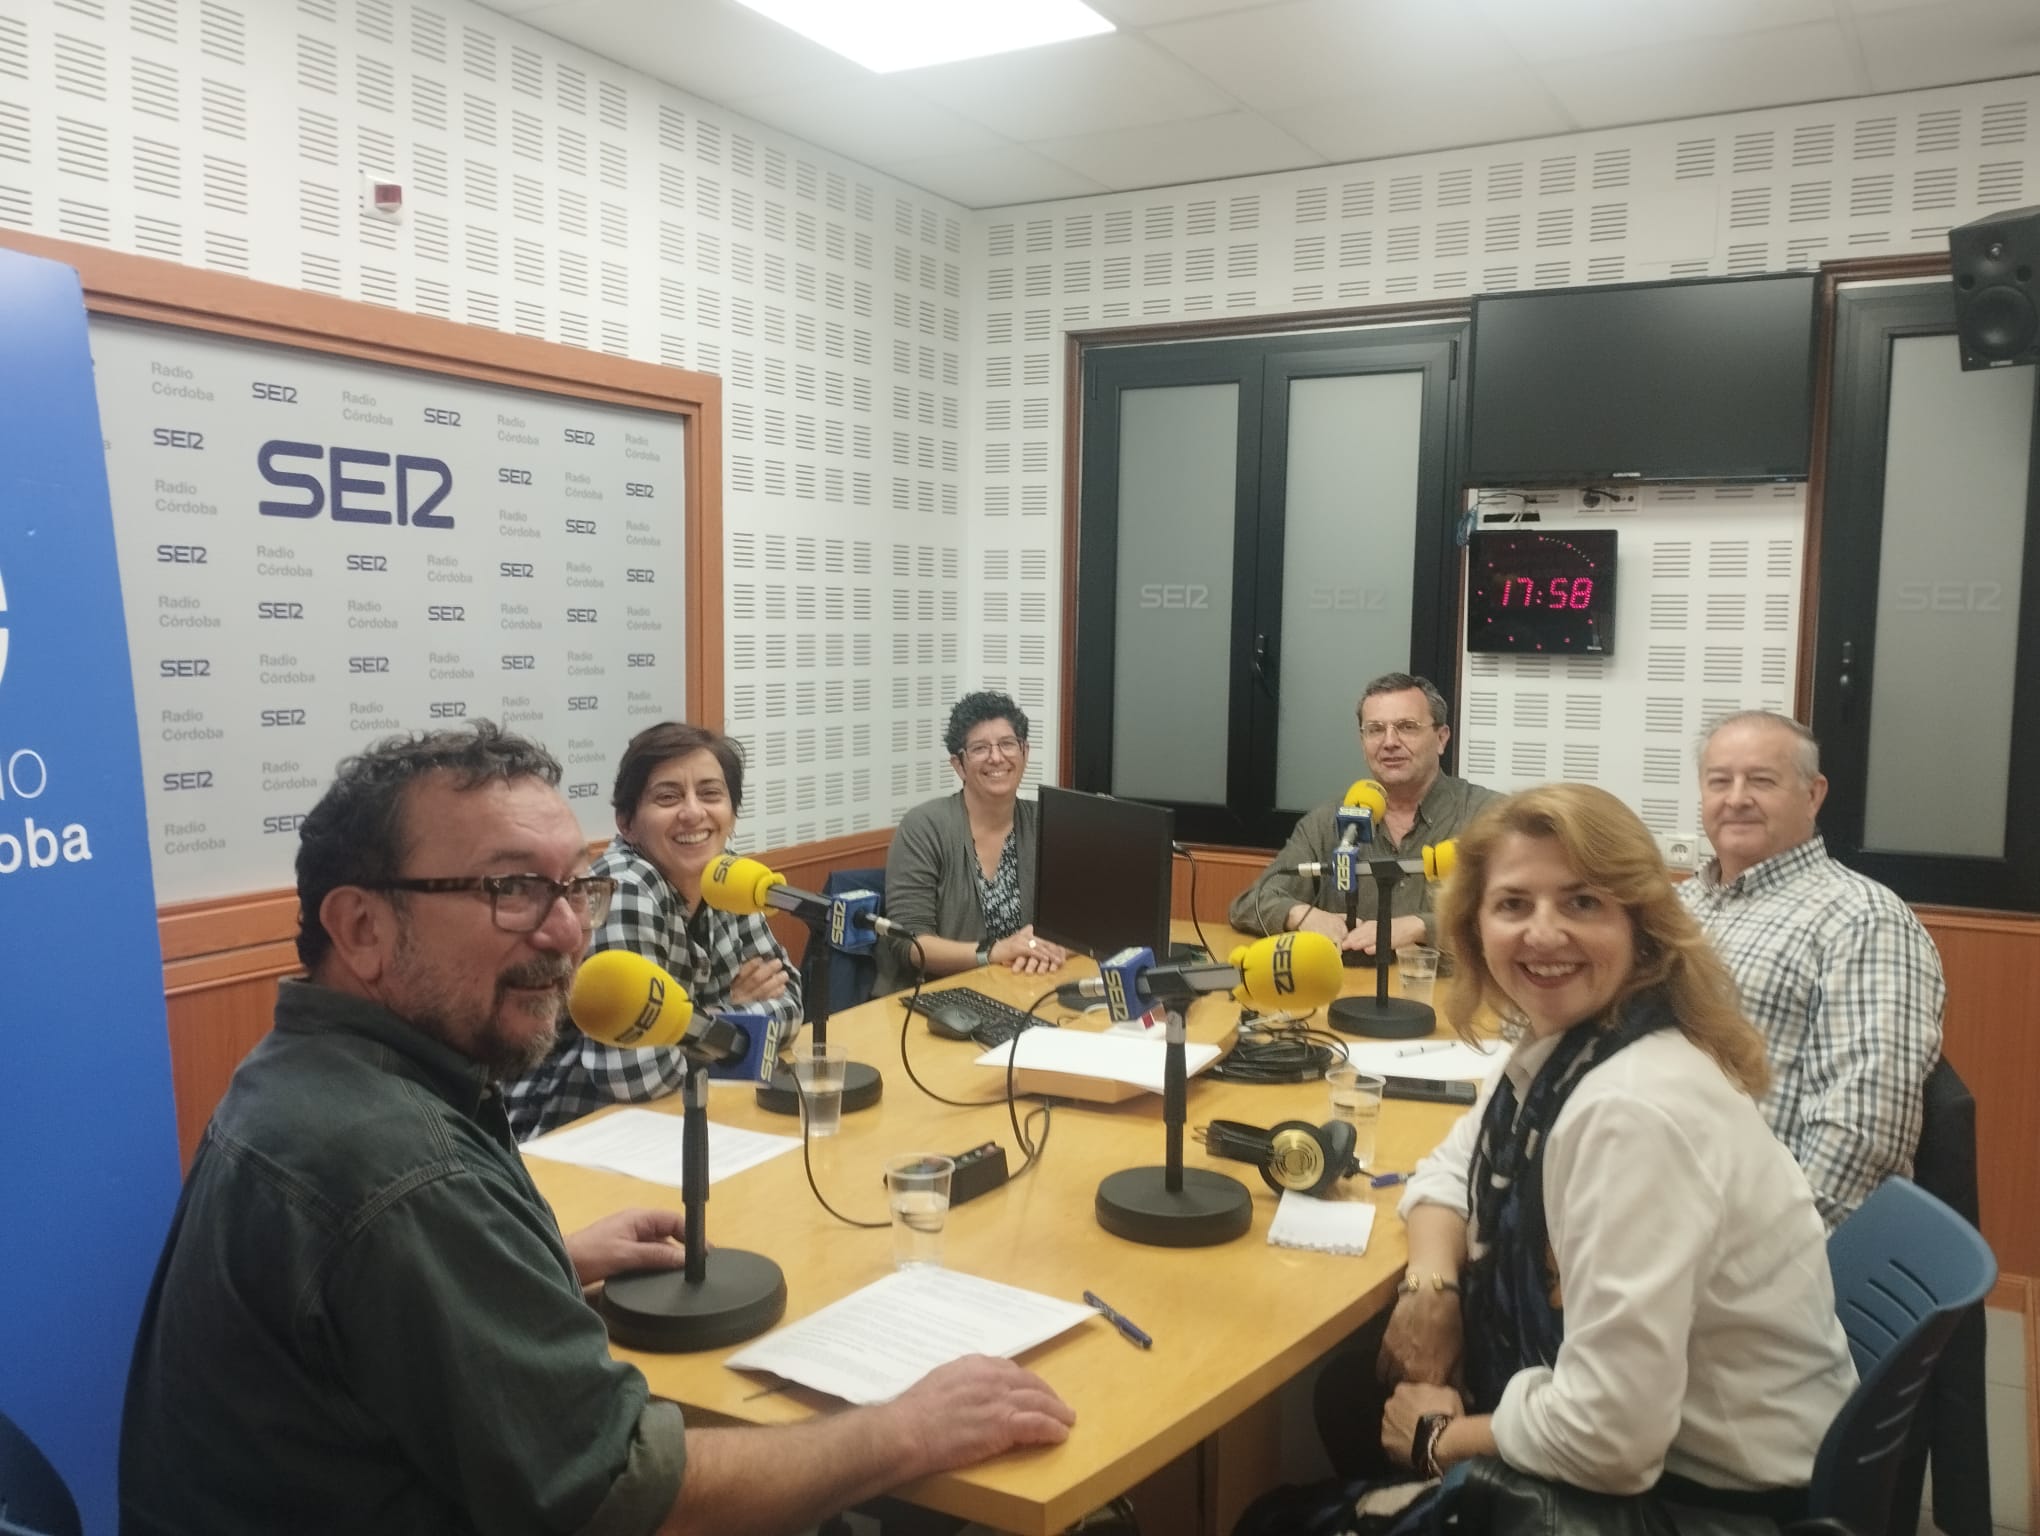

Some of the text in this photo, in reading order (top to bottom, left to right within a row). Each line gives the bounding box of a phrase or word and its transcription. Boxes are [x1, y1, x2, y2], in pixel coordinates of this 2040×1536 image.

[151, 362, 193, 380] Radio
[152, 381, 214, 402] Córdoba
[252, 382, 298, 404] SER
[342, 391, 376, 407] Radio
[424, 408, 461, 427] SER
[497, 414, 526, 429] Radio
[153, 428, 204, 450] SER
[564, 428, 595, 446] SER
[625, 433, 648, 446] Radio
[257, 439, 455, 529] SER
[498, 468, 533, 486] SER
[565, 472, 591, 485] Radio
[155, 479, 197, 496] Radio
[626, 482, 654, 499] SER
[155, 498, 218, 516] Córdoba
[500, 510, 527, 523] Radio
[566, 519, 596, 535] SER
[626, 520, 650, 533] Radio
[157, 545, 207, 564] SER
[257, 545, 295, 560] Radio
[346, 554, 388, 572] SER
[427, 554, 458, 568] Radio
[566, 561, 592, 574] Radio
[257, 563, 313, 578] Córdoba
[500, 562, 534, 578] SER
[626, 569, 655, 583] SER
[1138, 584, 1209, 608] SER
[1502, 577, 1593, 609] 17:58
[158, 596, 201, 610] Radio
[258, 602, 304, 620] SER
[347, 600, 382, 613] Radio
[501, 603, 529, 615] Radio
[428, 606, 465, 621] SER
[567, 608, 598, 623] SER
[627, 606, 650, 617] Radio
[158, 614, 221, 629] Córdoba
[347, 616, 398, 630] Córdoba
[259, 654, 297, 667] Radio
[349, 656, 390, 673] SER
[429, 652, 460, 664] Radio
[501, 655, 535, 670] SER
[567, 651, 593, 662] Radio
[627, 653, 655, 667] SER
[160, 659, 210, 677] SER
[259, 669, 315, 684] Córdoba
[502, 696, 530, 707] Radio
[567, 696, 599, 711] SER
[627, 690, 651, 701] Radio
[162, 709, 203, 723] Radio
[349, 702, 384, 715] Radio
[429, 701, 467, 718] SER
[261, 709, 306, 727] SER
[350, 717, 400, 731] Córdoba
[162, 726, 224, 742] Córdoba
[568, 738, 594, 750] Radio
[262, 760, 300, 774] Radio
[163, 770, 214, 791] SER
[262, 777, 318, 792] Córdoba
[568, 783, 599, 799] SER
[164, 820, 206, 838] Radio
[164, 837, 226, 856] Córdoba
[1336, 853, 1351, 891] SER
[831, 900, 847, 946] SER
[1273, 932, 1297, 997] SER
[1105, 969, 1130, 1022] SER
[613, 977, 665, 1044] SER
[760, 1020, 780, 1083] SER
